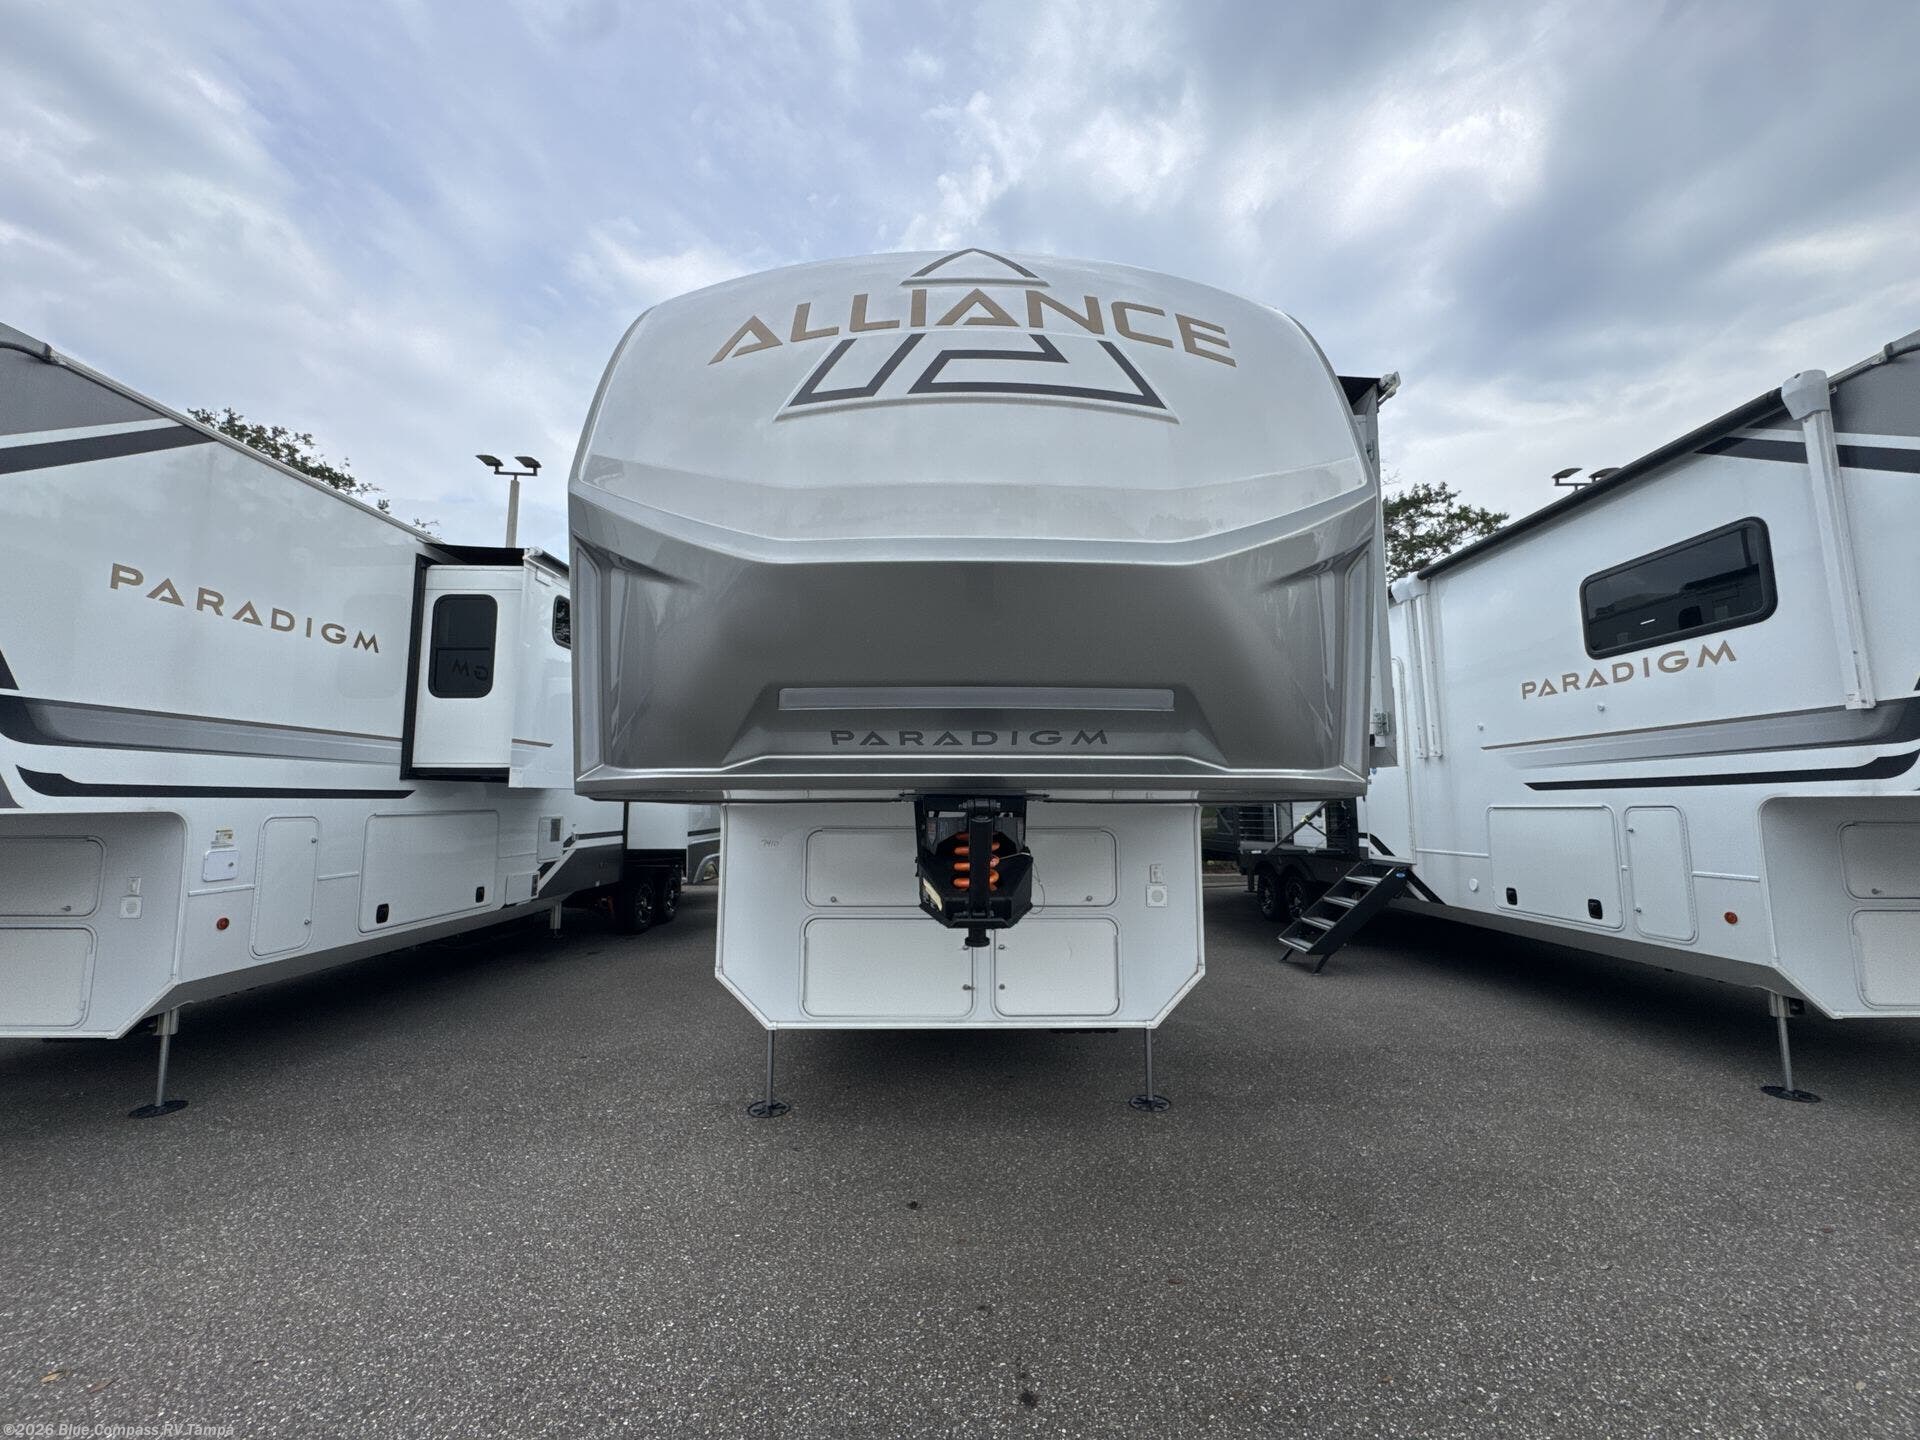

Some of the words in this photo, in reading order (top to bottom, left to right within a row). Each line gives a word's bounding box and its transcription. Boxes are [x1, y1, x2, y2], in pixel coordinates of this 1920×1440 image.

[707, 288, 1237, 367] ALLIANCE
[110, 563, 380, 654] PARADIGM
[1521, 640, 1737, 699] PARADIGM
[830, 730, 1108, 746] PARADIGM
